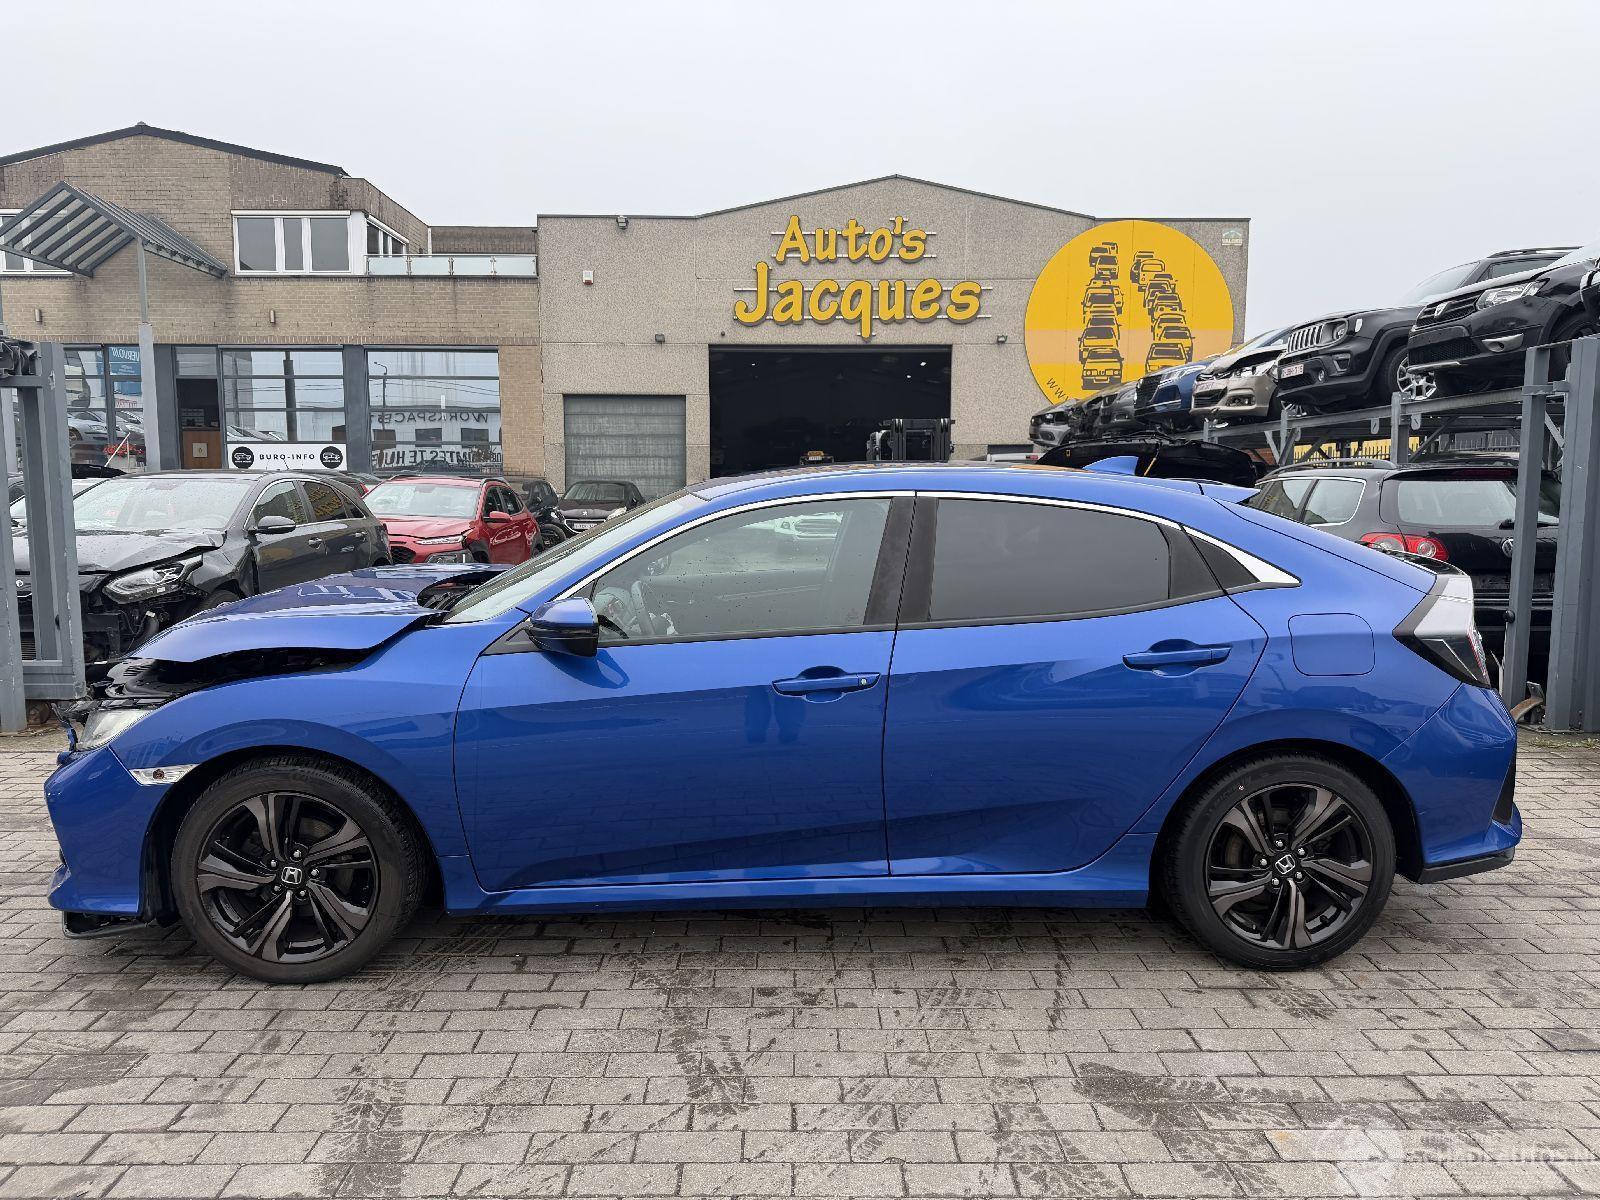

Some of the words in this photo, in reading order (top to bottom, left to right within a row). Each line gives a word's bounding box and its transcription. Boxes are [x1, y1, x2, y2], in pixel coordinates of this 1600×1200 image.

[774, 214, 928, 264] Auto's
[733, 261, 983, 342] Jacques
[1046, 377, 1069, 401] ww
[259, 453, 315, 461] BURO-INFO
